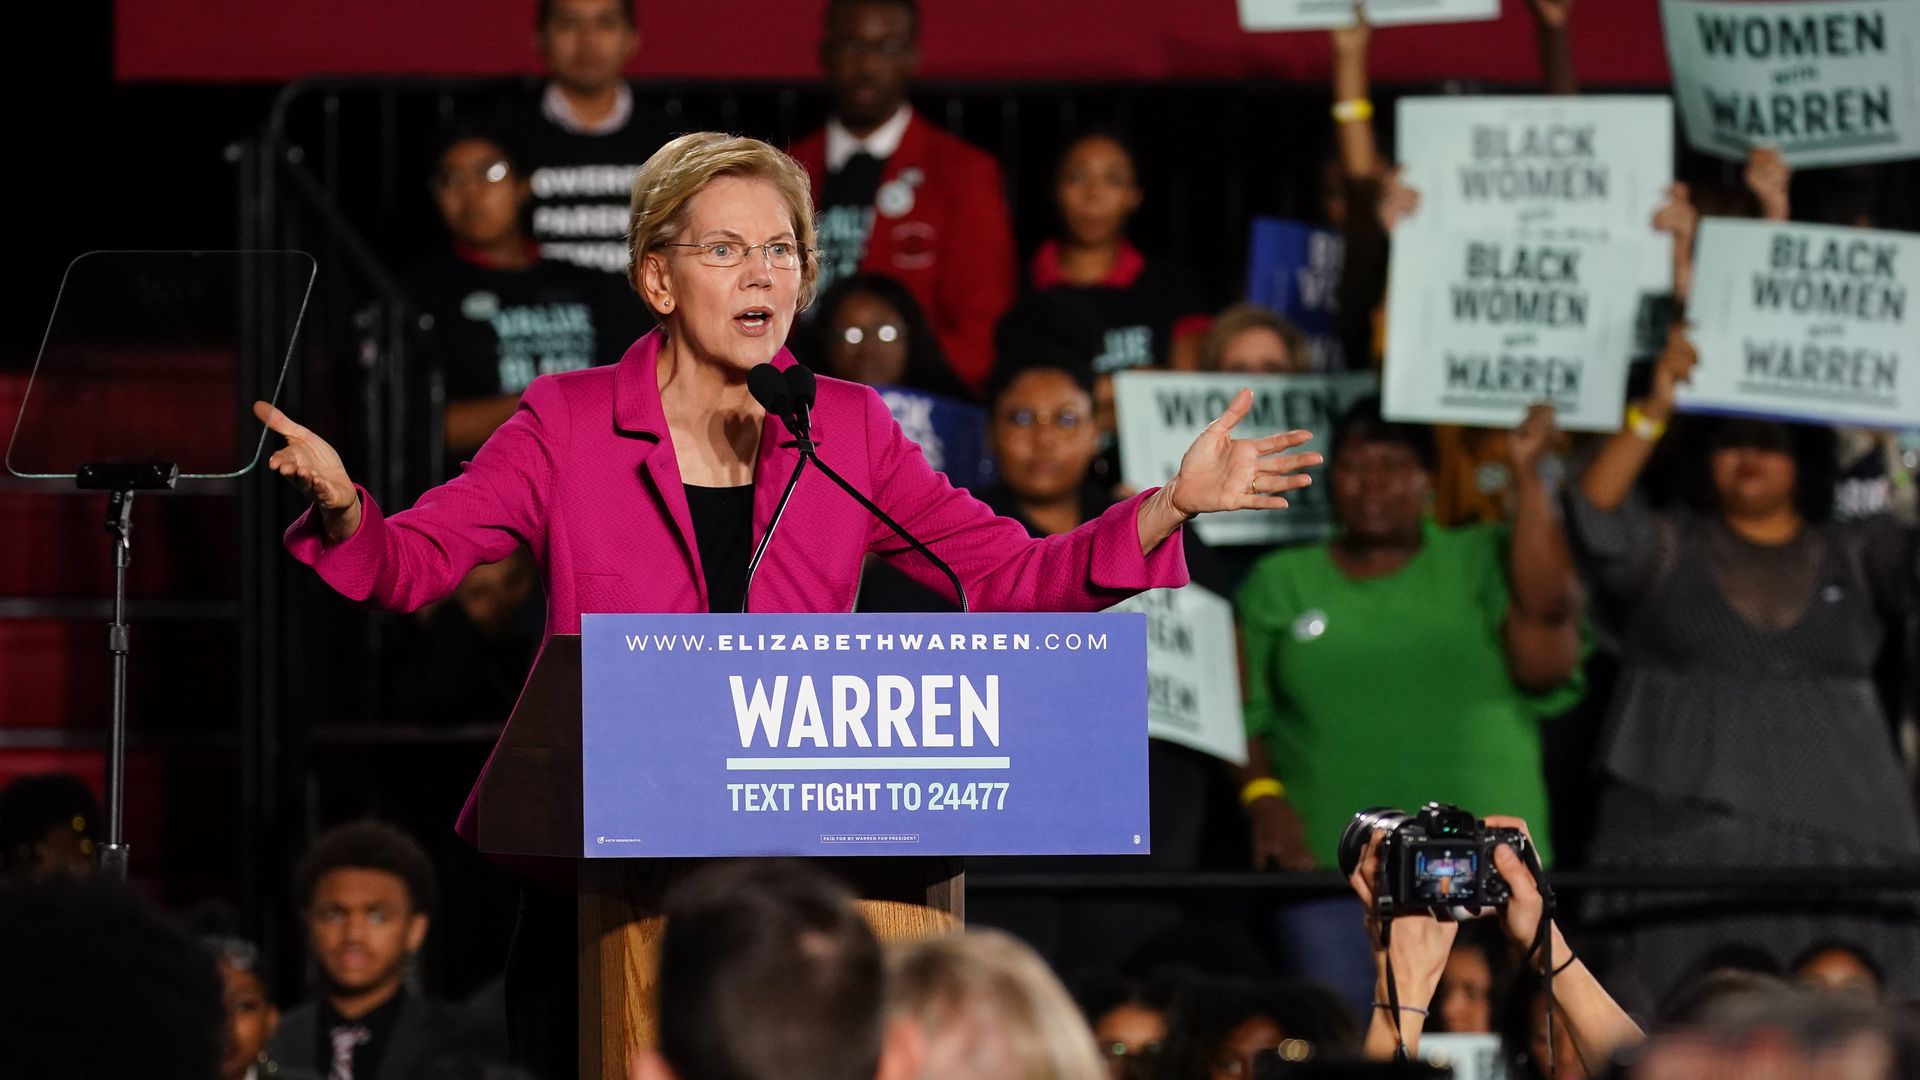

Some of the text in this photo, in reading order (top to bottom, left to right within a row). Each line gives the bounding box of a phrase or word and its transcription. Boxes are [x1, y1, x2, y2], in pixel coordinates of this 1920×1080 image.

[1696, 12, 1884, 58] WOMEN
[1703, 85, 1891, 136] WARREN
[1472, 124, 1596, 159] BLACK
[1459, 164, 1610, 202] WOMEN
[1466, 242, 1581, 283] BLACK
[1770, 233, 1898, 278] BLACK
[1450, 286, 1588, 328] WOMEN
[1752, 272, 1908, 323] WOMEN
[1445, 352, 1582, 396] WARREN
[1742, 338, 1899, 389] WARREN
[625, 633, 1108, 651] WWW.ELIZABETHWARREN.COM
[729, 674, 1000, 748] WARREN
[726, 782, 1010, 811] TEXT FIGHT TO 24477
